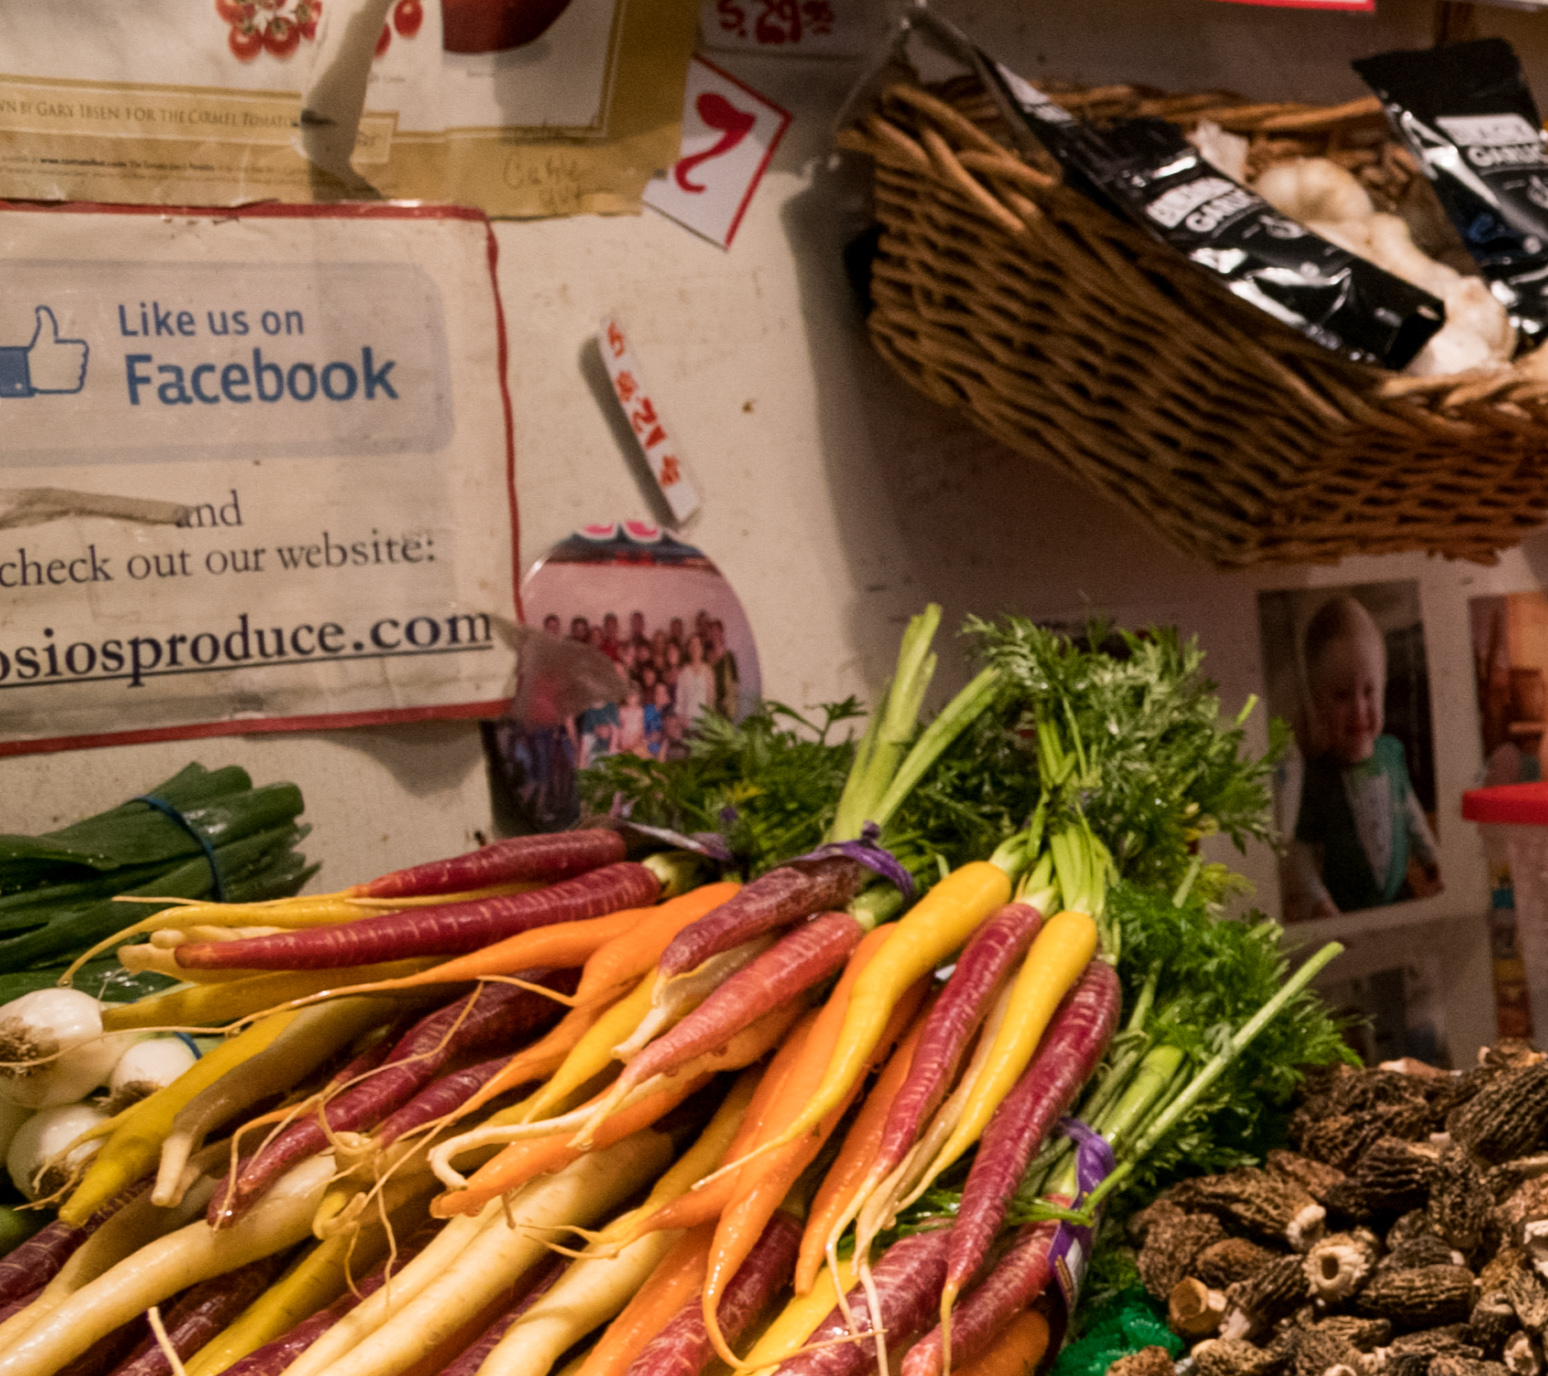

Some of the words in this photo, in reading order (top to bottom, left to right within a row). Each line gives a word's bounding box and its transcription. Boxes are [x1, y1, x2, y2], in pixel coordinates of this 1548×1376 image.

[37, 101, 74, 119] GARY
[80, 104, 121, 122] IBSEN
[125, 105, 156, 123] FOR
[160, 108, 185, 125] THE
[188, 110, 238, 127] CARMEL
[117, 300, 196, 337] Like
[206, 307, 250, 338] us
[260, 303, 305, 337] on
[123, 344, 400, 408] Facebook
[0, 544, 114, 588] check
[127, 550, 192, 580] out
[205, 548, 266, 574] our
[277, 529, 436, 570] website:
